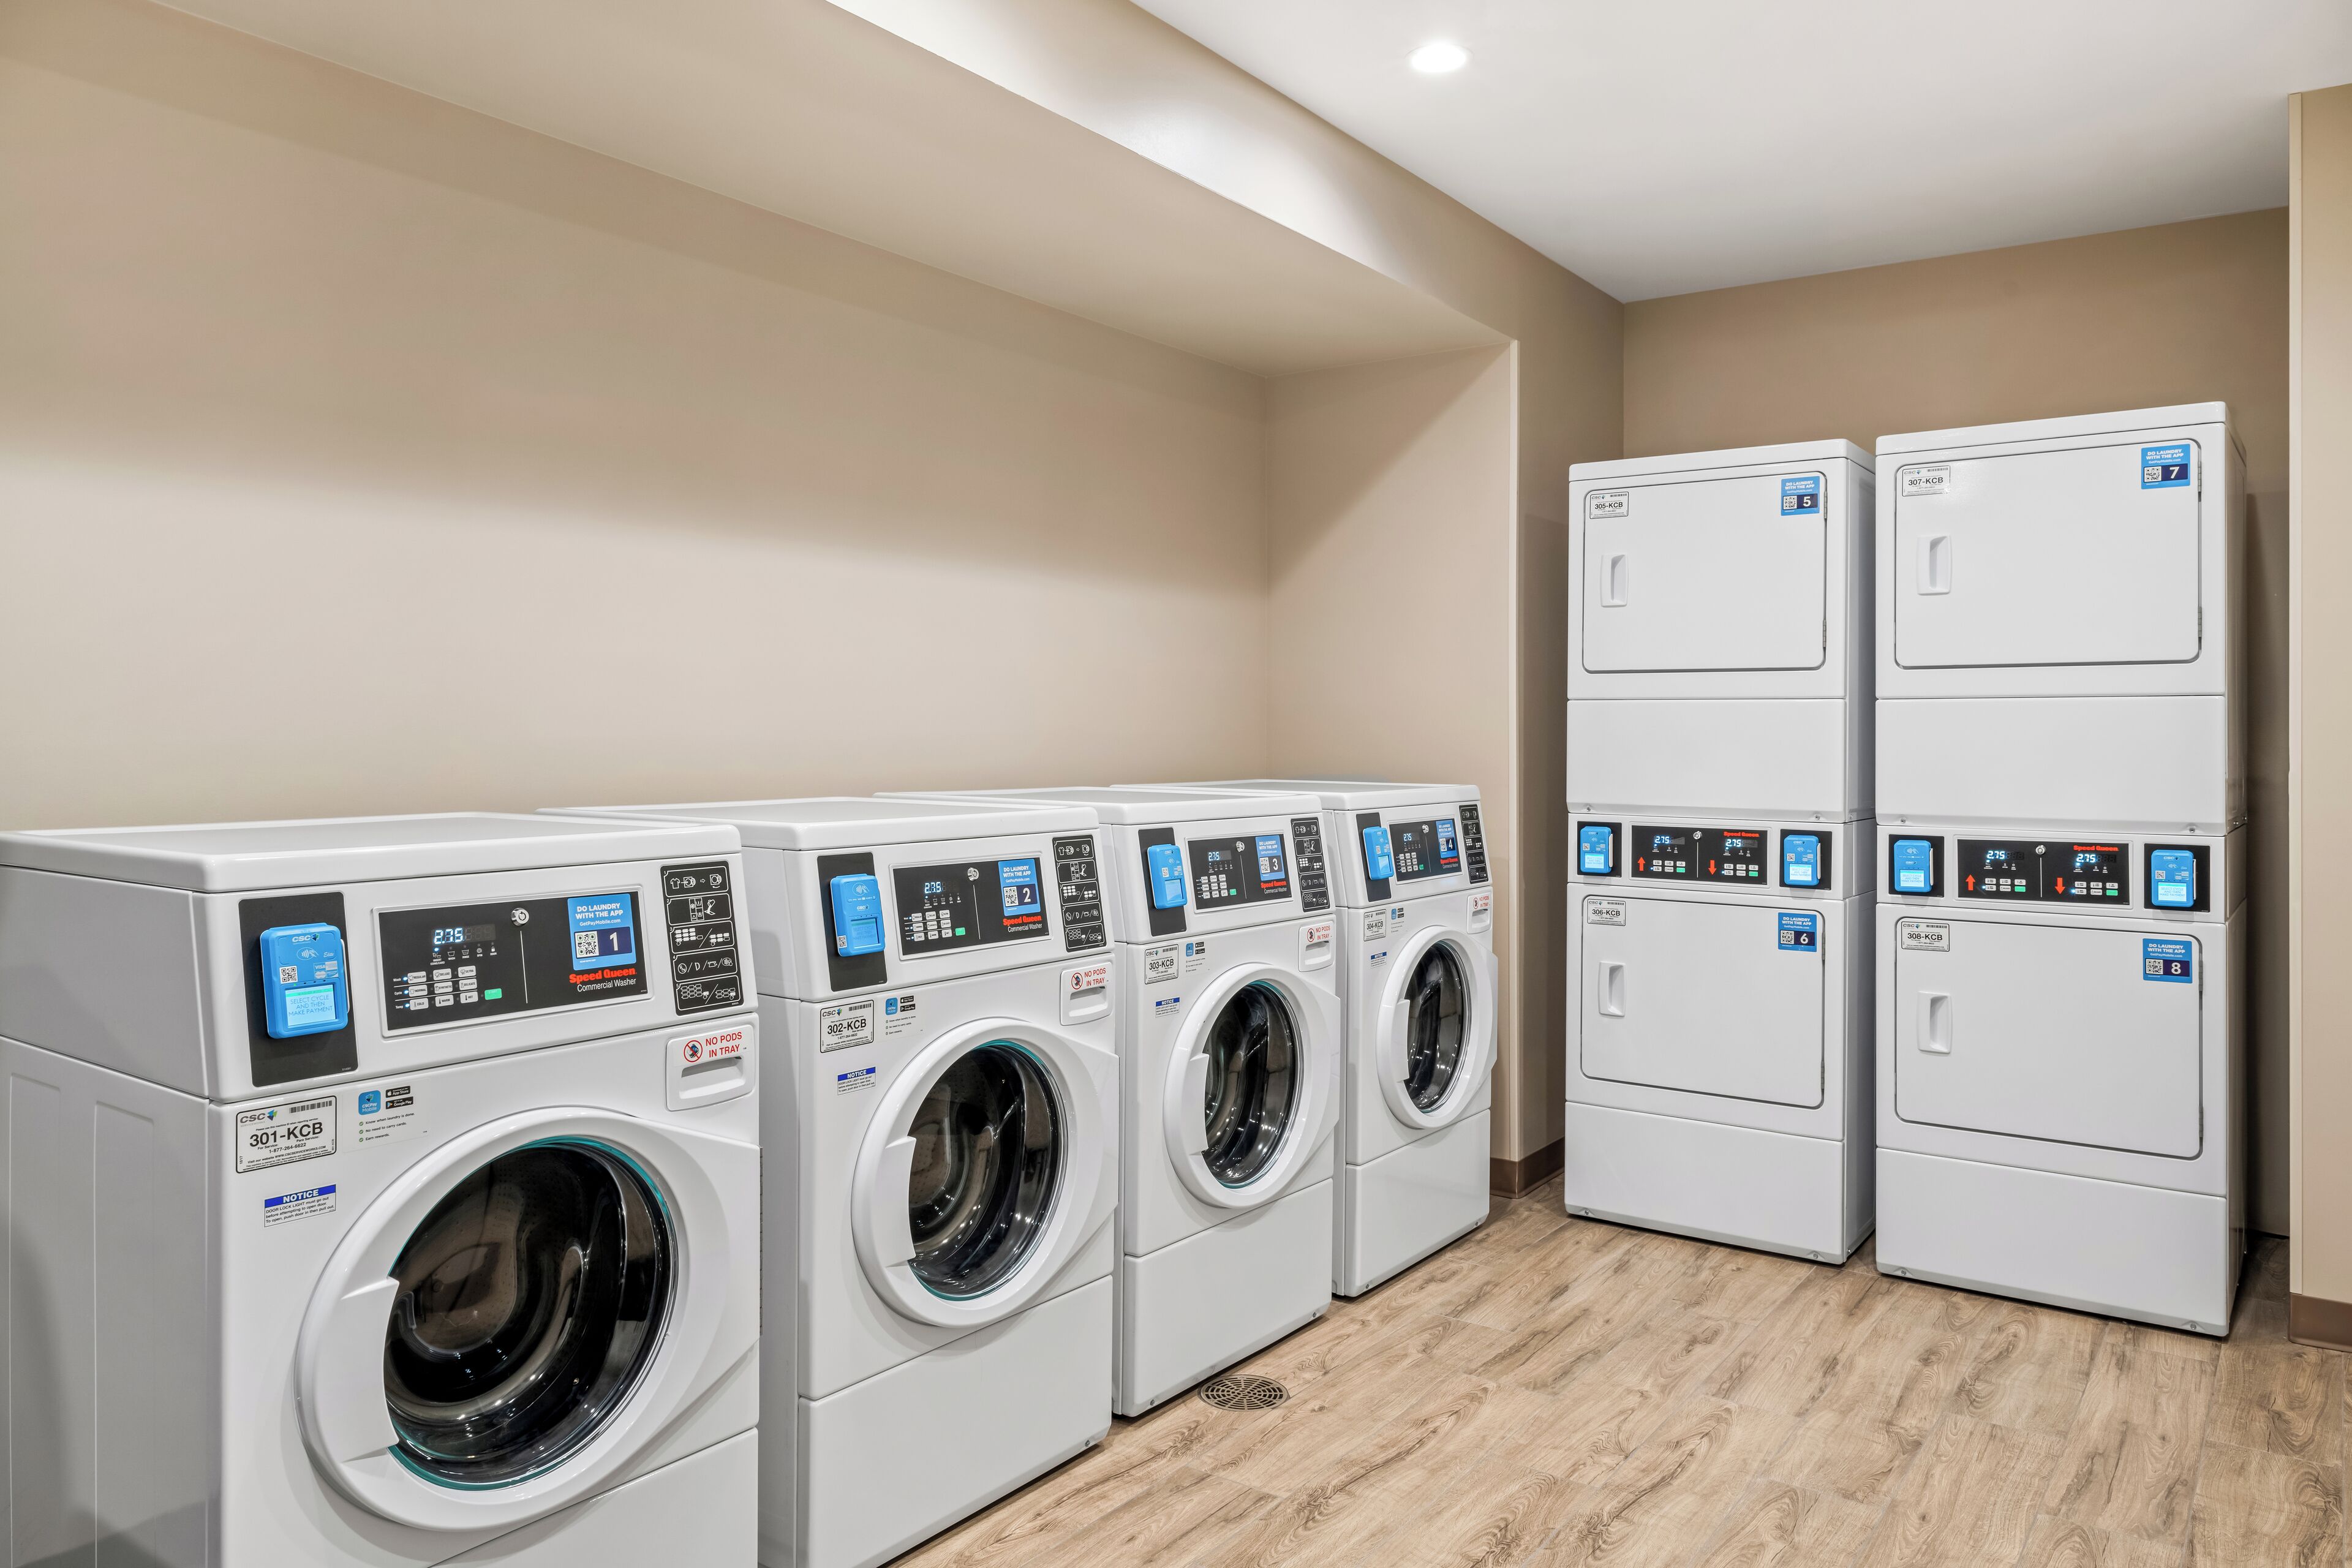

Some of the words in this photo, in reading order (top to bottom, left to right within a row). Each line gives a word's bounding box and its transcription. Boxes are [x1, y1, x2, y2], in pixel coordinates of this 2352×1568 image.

[2169, 467, 2179, 478] 7
[1803, 497, 1811, 507] 5
[1449, 839, 1453, 849] 4
[1987, 851, 2005, 859] 2.75
[2076, 854, 2095, 862] 2.75
[1273, 859, 1278, 870] 3
[1023, 888, 1031, 902] 2
[589, 903, 620, 911] LAUNDRY
[1003, 917, 1022, 926] Speed
[1367, 921, 1383, 930] 304-KCB
[434, 928, 464, 944] 2.75
[609, 932, 618, 951] 1
[1801, 933, 1808, 944] 6
[1149, 959, 1174, 970] 303-KCB
[2171, 962, 2181, 974] 8
[569, 970, 602, 984] Speed
[604, 968, 636, 978] Queen
[578, 982, 612, 992] Commercial
[615, 978, 636, 987] Washer
[827, 1019, 866, 1035] 302-KCB
[706, 1037, 717, 1046] NO
[720, 1032, 742, 1043] PODS
[709, 1049, 717, 1058] IN
[719, 1044, 740, 1055] TRAY
[848, 1070, 867, 1079] NOTICE
[240, 1113, 266, 1123] CSC
[249, 1121, 323, 1147] 301-KCB
[269, 1143, 306, 1154] 1-877-264-6622
[283, 1189, 318, 1204] NOTICE
